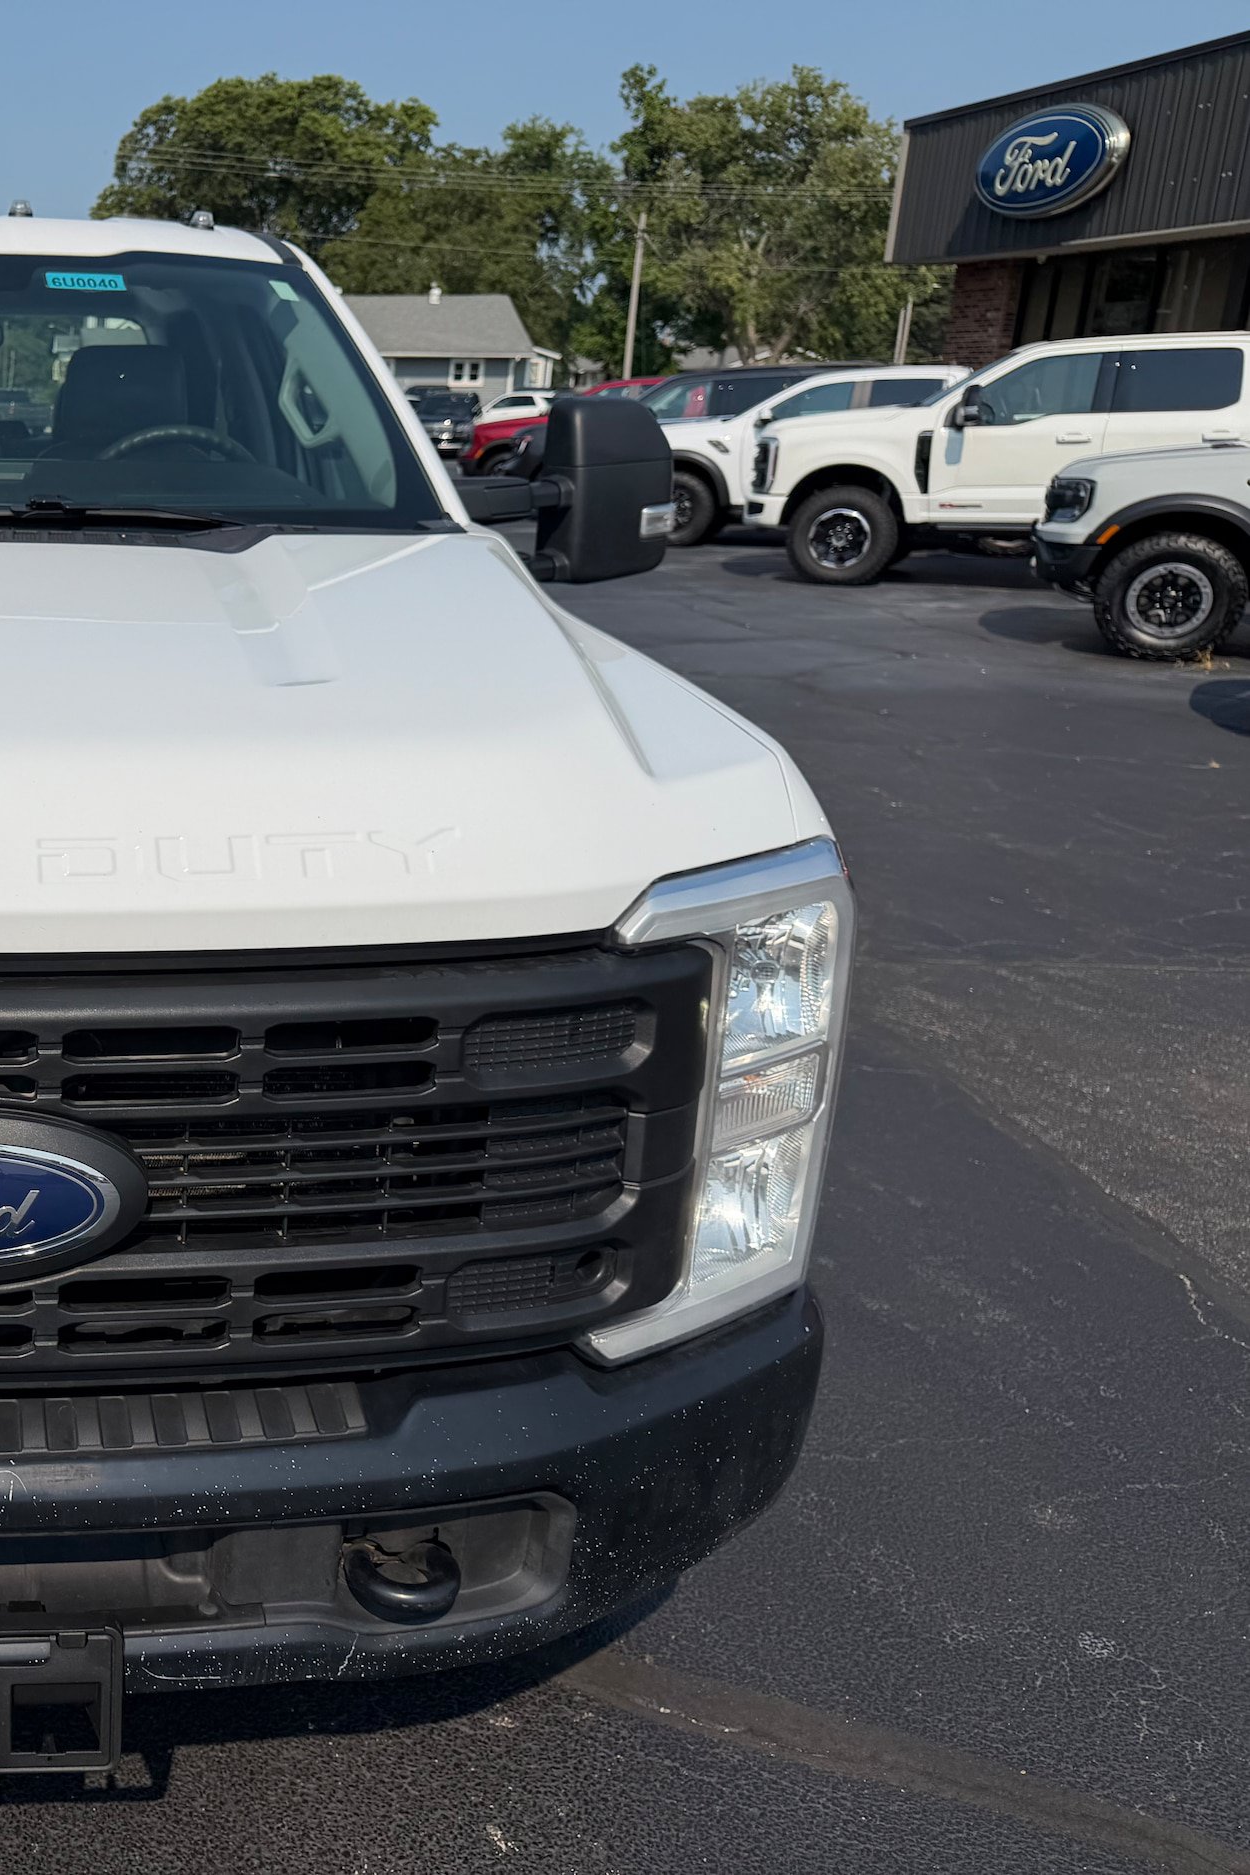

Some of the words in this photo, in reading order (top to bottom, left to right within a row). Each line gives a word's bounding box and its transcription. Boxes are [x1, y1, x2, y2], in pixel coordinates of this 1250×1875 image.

[993, 131, 1078, 197] Ford
[51, 276, 119, 290] 6U0040
[34, 826, 462, 886] DUTY
